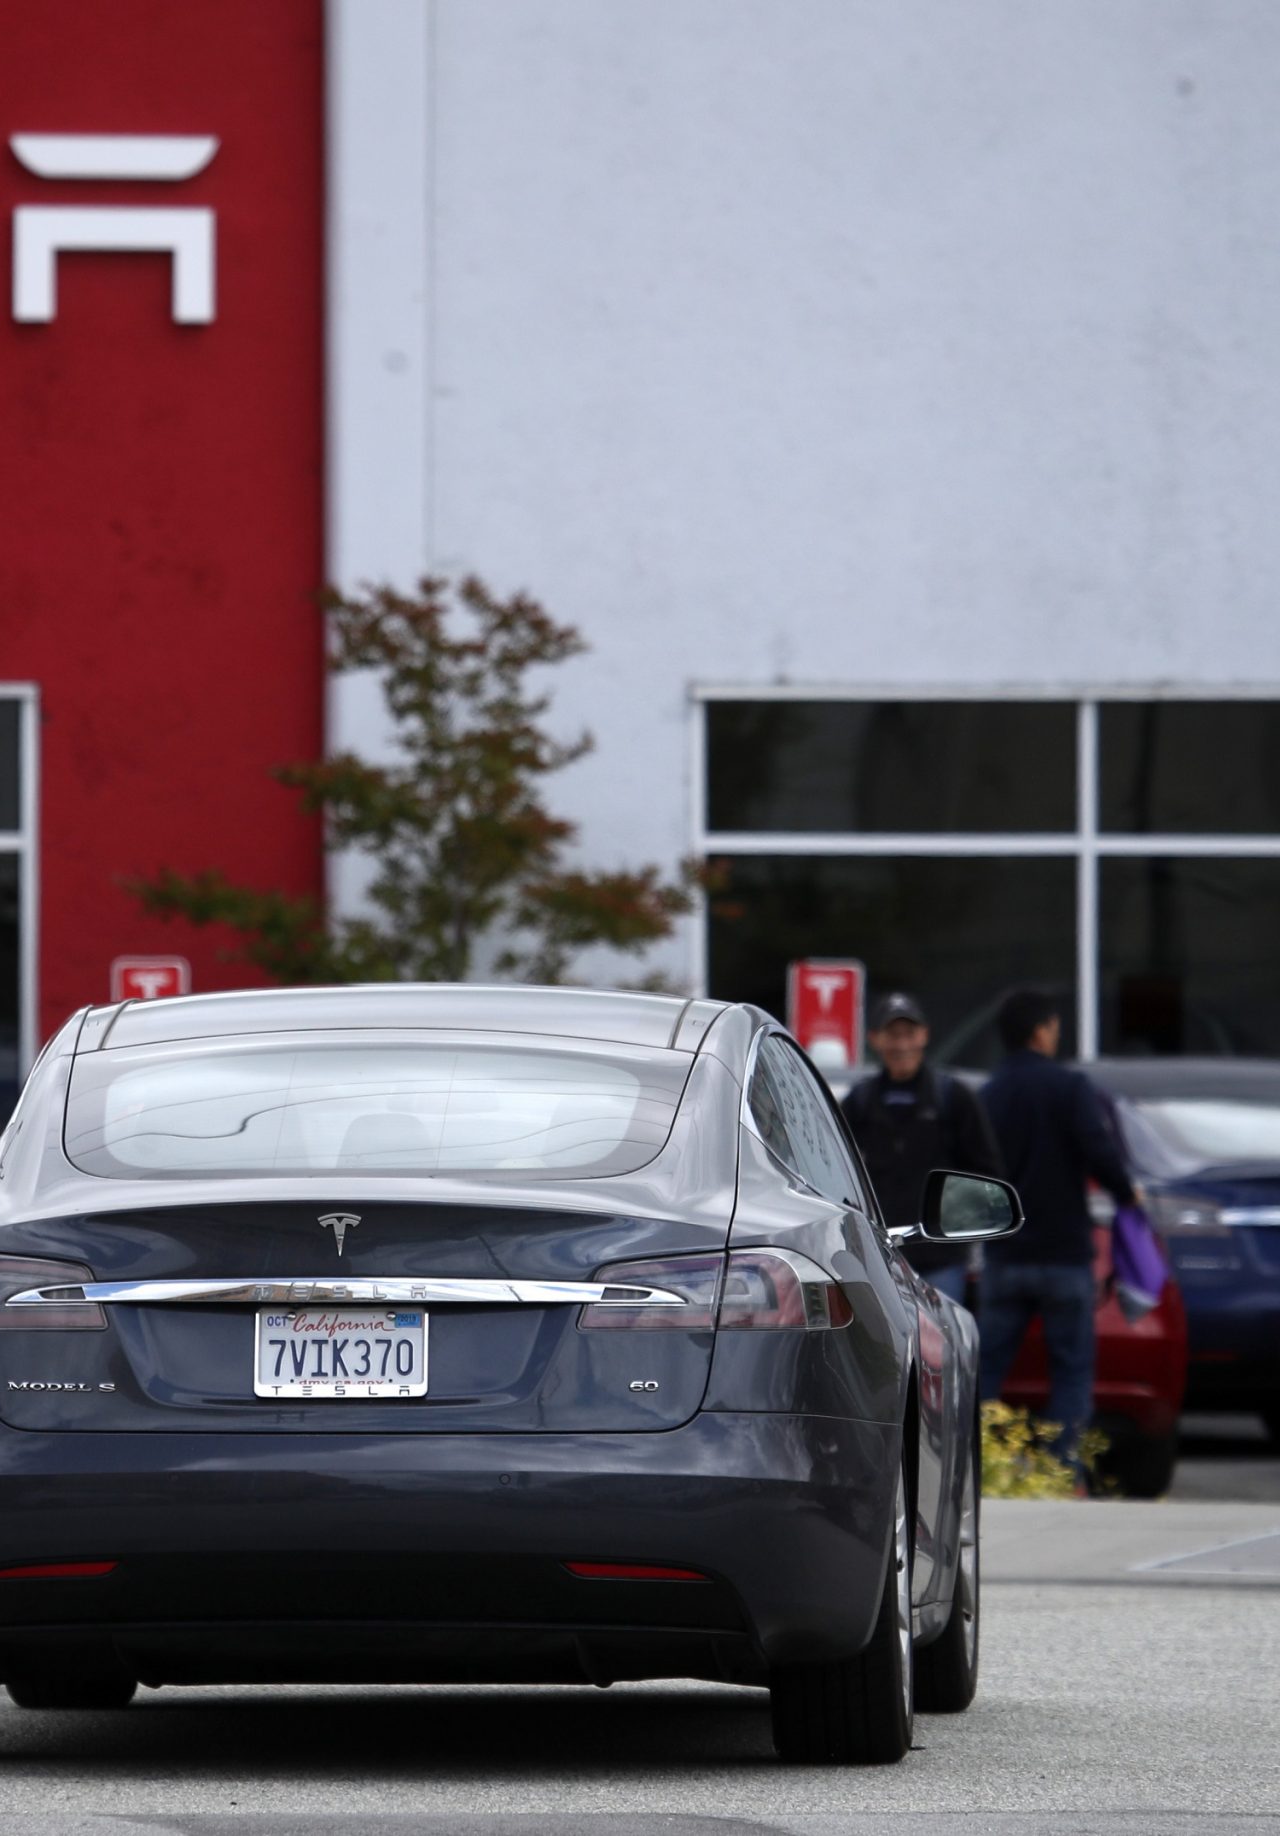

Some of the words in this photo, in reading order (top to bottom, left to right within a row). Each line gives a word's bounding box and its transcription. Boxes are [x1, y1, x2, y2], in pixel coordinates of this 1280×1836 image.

[255, 1284, 427, 1300] TESLA
[267, 1315, 288, 1327] OCT
[292, 1313, 395, 1338] California
[269, 1339, 413, 1377] 7VIK370
[7, 1381, 93, 1392] MODEL
[99, 1382, 116, 1393] S
[271, 1385, 410, 1396] TESLA
[630, 1381, 659, 1391] 60
